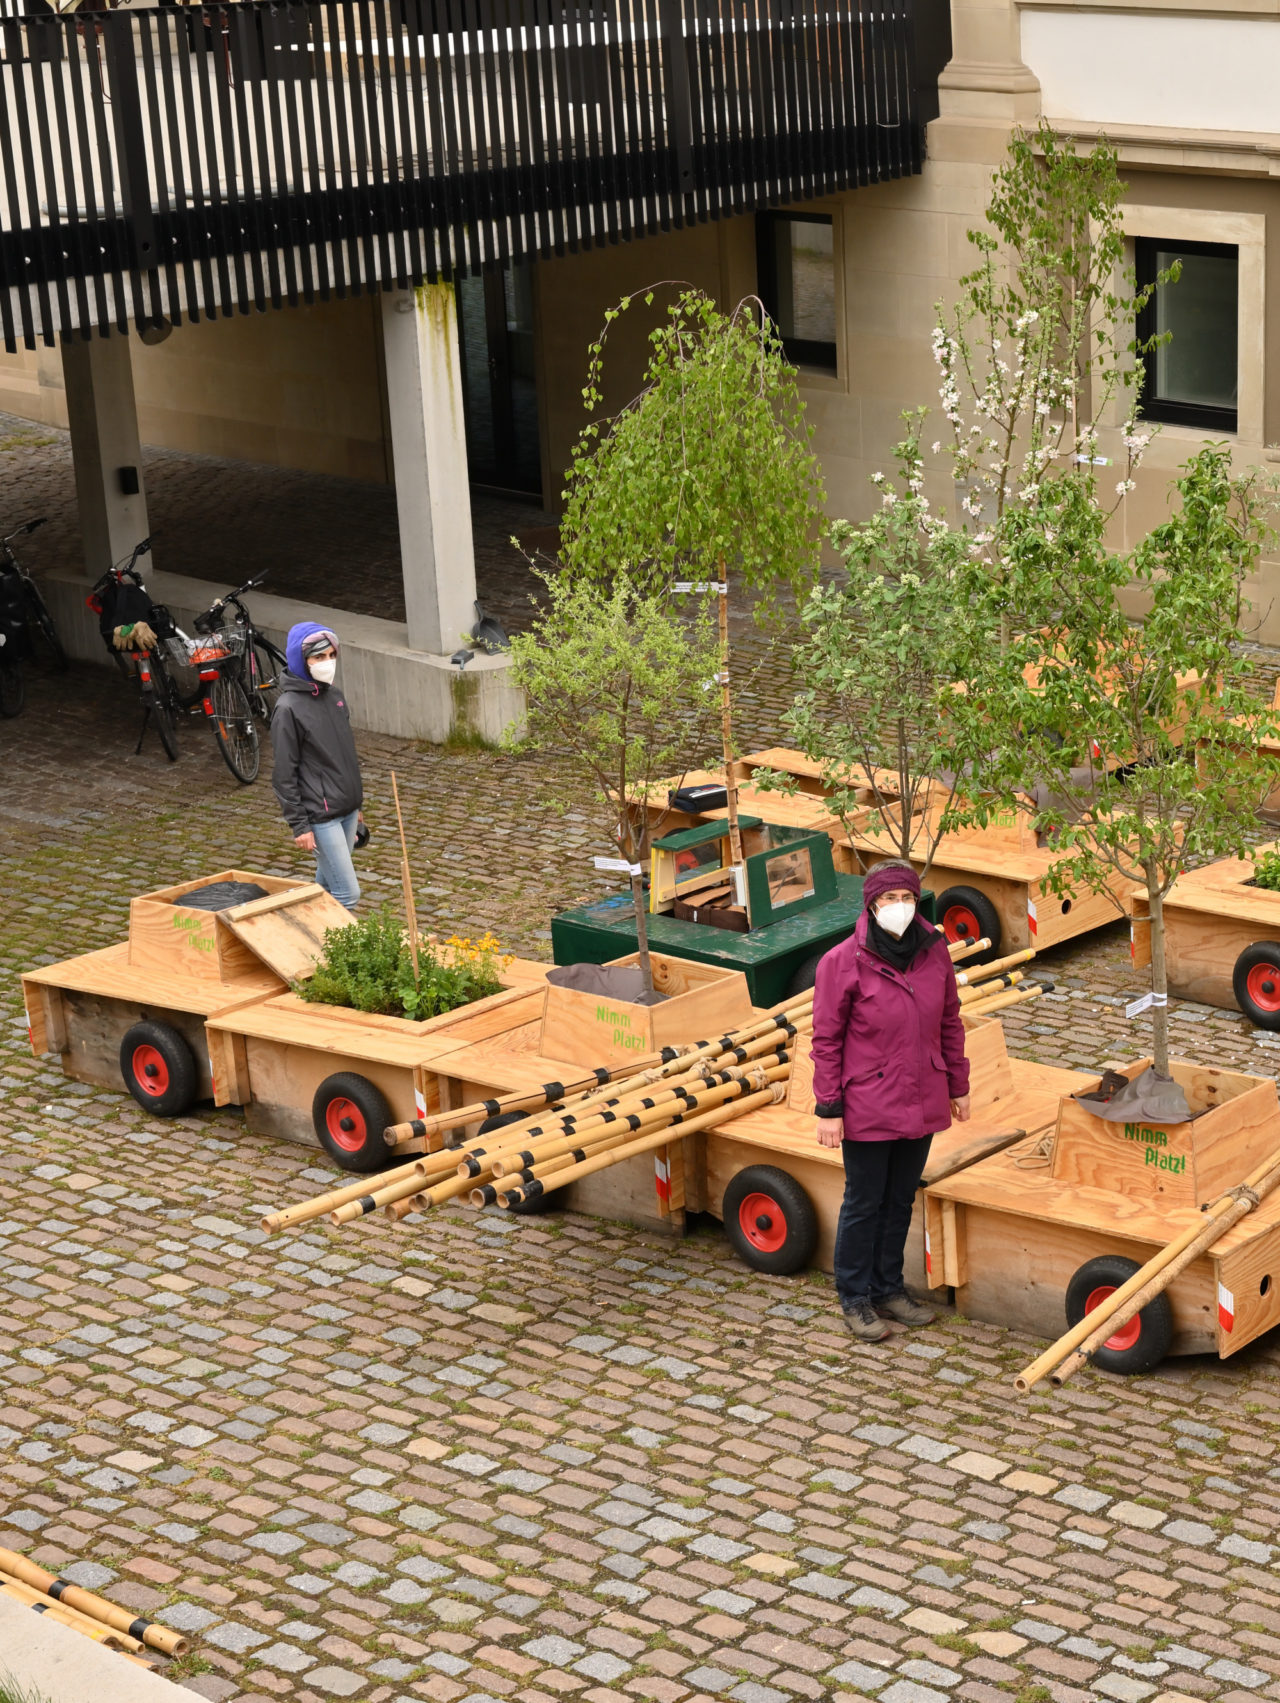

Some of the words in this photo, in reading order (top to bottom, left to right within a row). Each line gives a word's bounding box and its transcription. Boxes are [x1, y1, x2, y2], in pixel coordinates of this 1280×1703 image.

[173, 912, 202, 930] Nimm
[188, 932, 215, 952] Platz!
[596, 1005, 631, 1028] Nimm
[613, 1029, 646, 1052] Platz!
[1125, 1122, 1168, 1147] Nimm
[1145, 1147, 1186, 1175] Platz!
